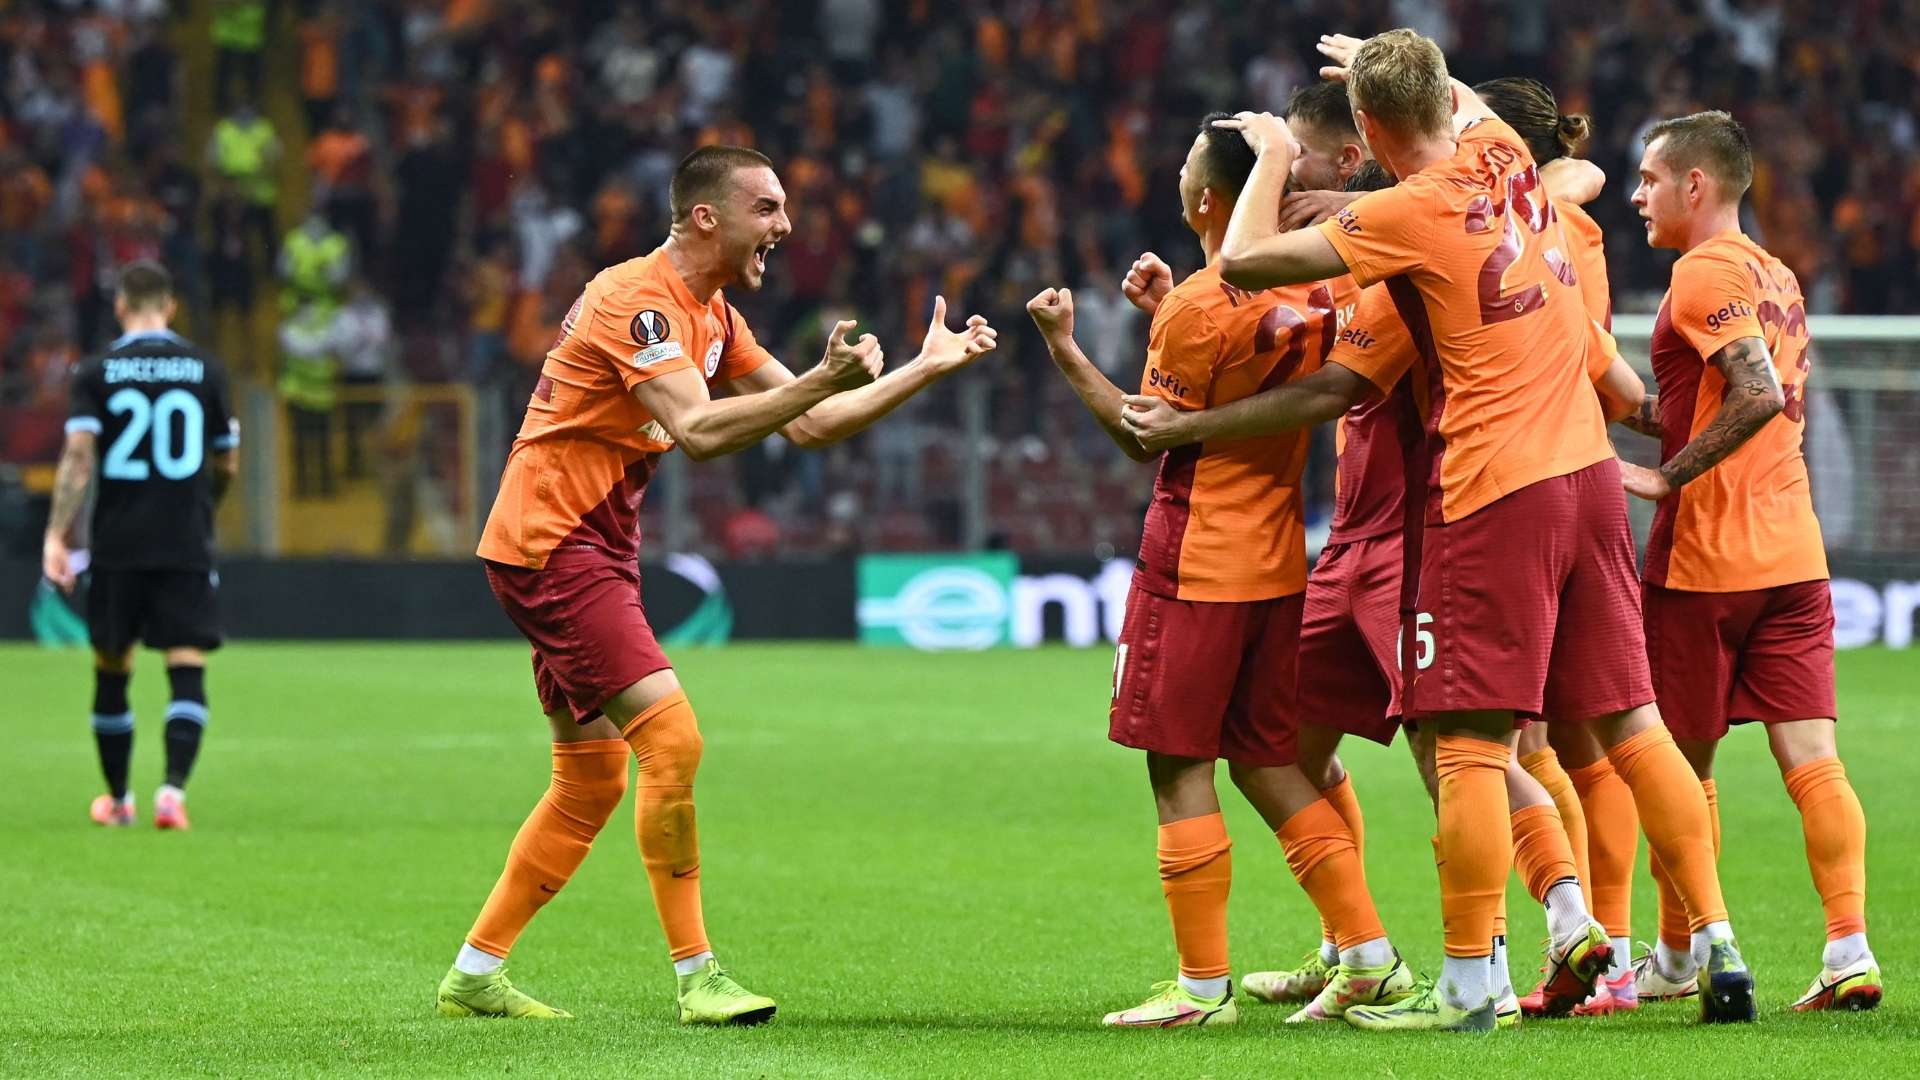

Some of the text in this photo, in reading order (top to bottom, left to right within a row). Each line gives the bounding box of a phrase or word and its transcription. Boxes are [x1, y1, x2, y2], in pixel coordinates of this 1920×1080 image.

[1464, 163, 1577, 327] 25
[1335, 328, 1376, 349] etir
[104, 388, 204, 481] 20
